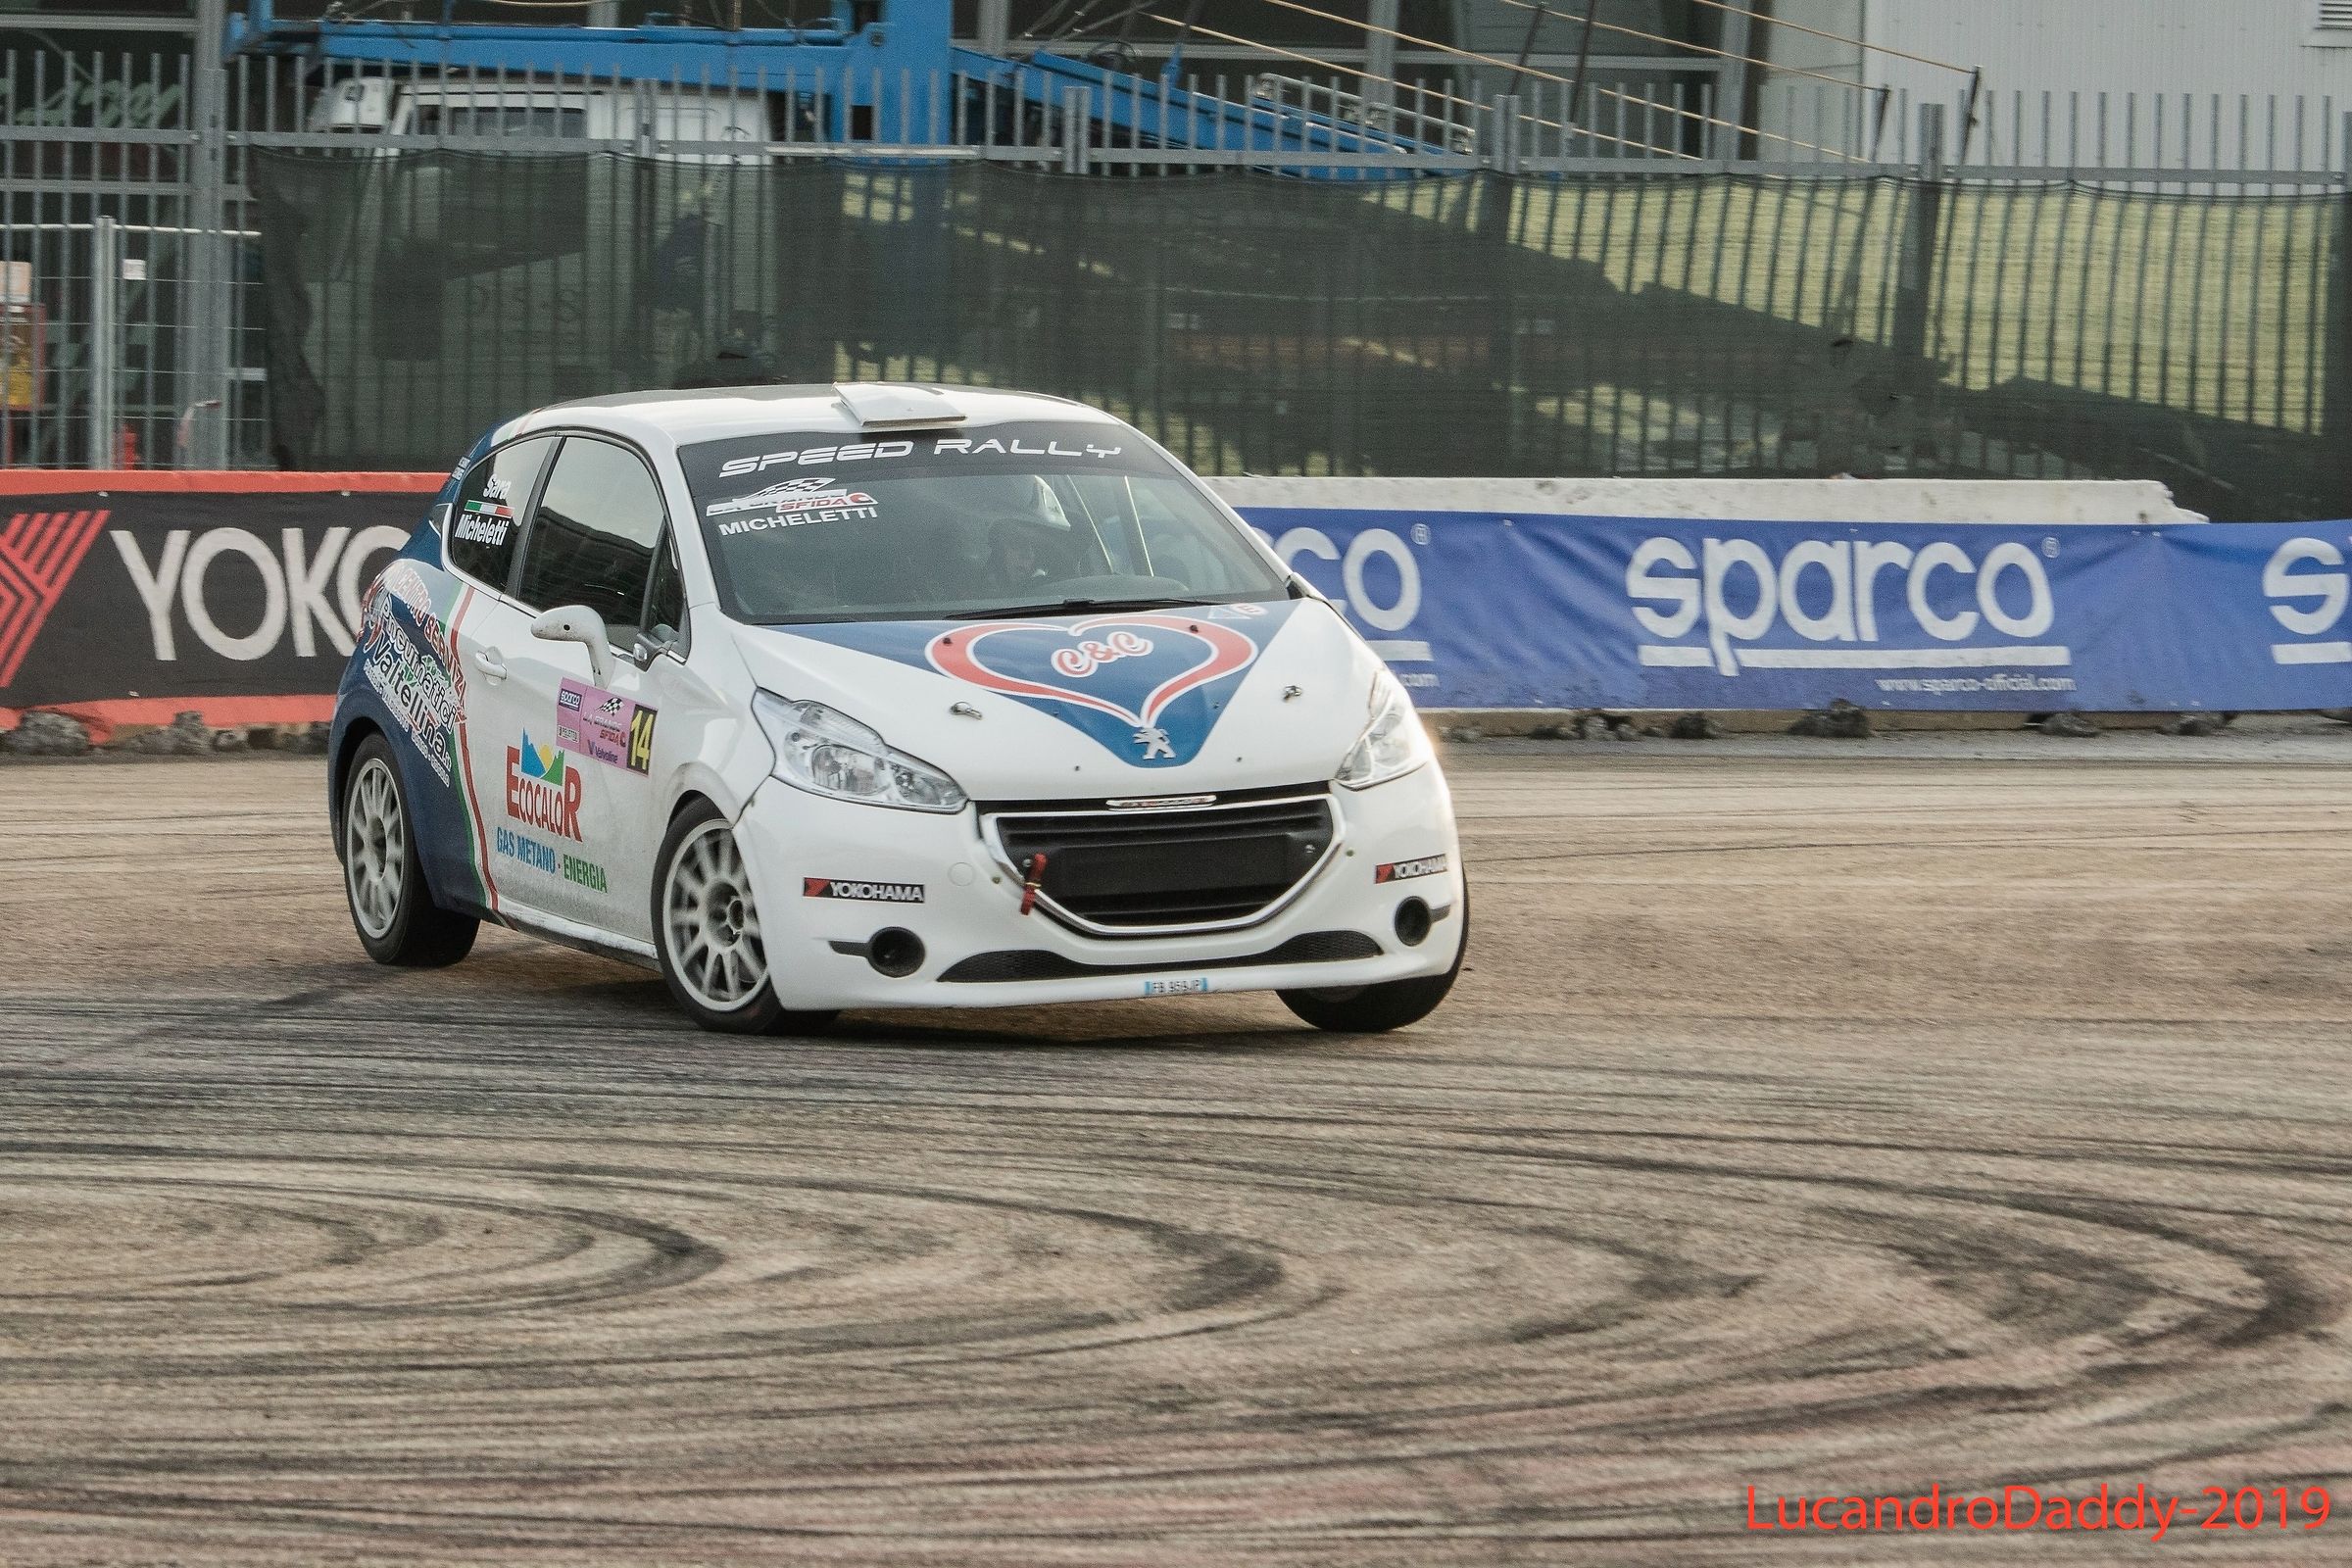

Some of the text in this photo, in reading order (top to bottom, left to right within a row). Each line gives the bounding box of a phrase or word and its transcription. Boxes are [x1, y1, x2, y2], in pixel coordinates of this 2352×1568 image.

[719, 438, 1122, 477] SPEED RALLY
[482, 473, 513, 500] Sara
[780, 497, 848, 511] SFIDA
[454, 514, 511, 546] Micheletti
[718, 507, 879, 536] MICHELETTI
[1625, 535, 2057, 677] sparco
[380, 593, 456, 734] Pneumatici
[1051, 630, 1154, 678] C&C
[372, 632, 446, 762] Valtellina
[561, 690, 581, 706] sparco
[599, 729, 619, 745] SFIDA
[630, 710, 654, 770] 14
[595, 747, 618, 763] Valvoline
[507, 745, 583, 843] ECOCALOR
[497, 826, 608, 893] GAS METANO ENERGIA
[830, 881, 924, 902] YOKOHAMA
